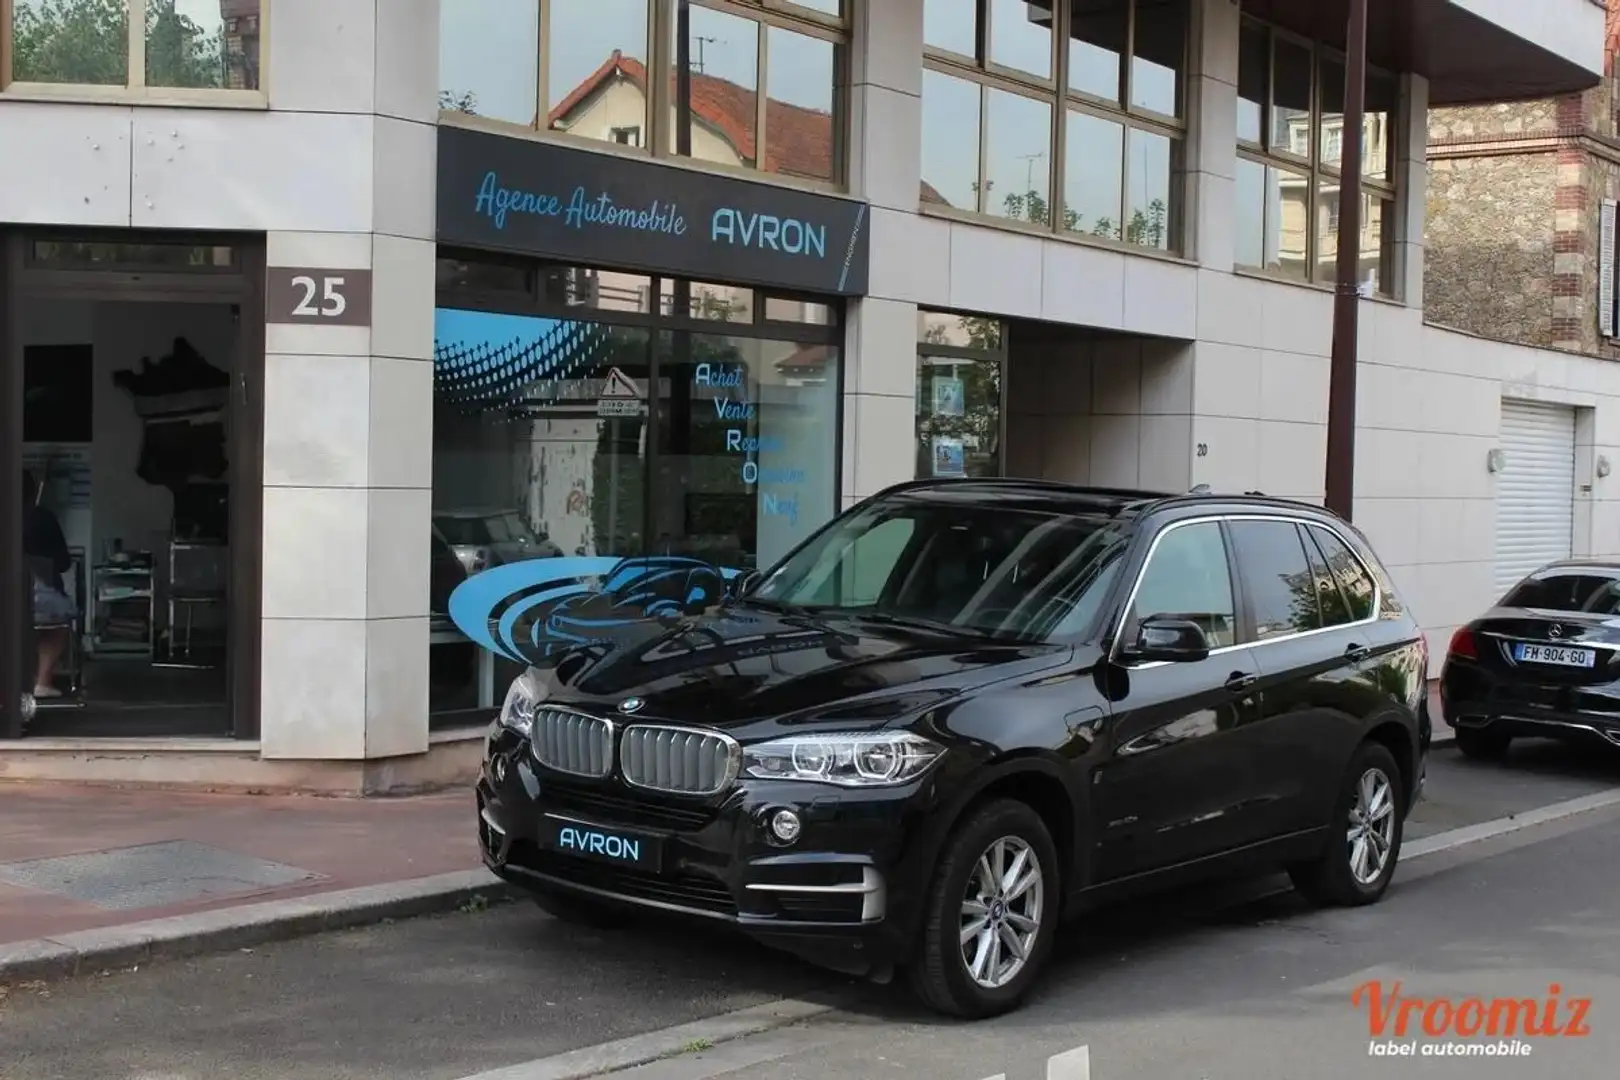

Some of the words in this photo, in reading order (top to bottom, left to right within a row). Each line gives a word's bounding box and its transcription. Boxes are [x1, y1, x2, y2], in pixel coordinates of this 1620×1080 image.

[475, 171, 562, 230] Agence
[564, 186, 687, 236] Automobile
[711, 207, 826, 258] AVRON
[290, 275, 347, 317] 25
[695, 362, 744, 388] Achat
[713, 395, 756, 420] Vente
[1197, 443, 1208, 457] 20
[559, 827, 640, 861] AVRON
